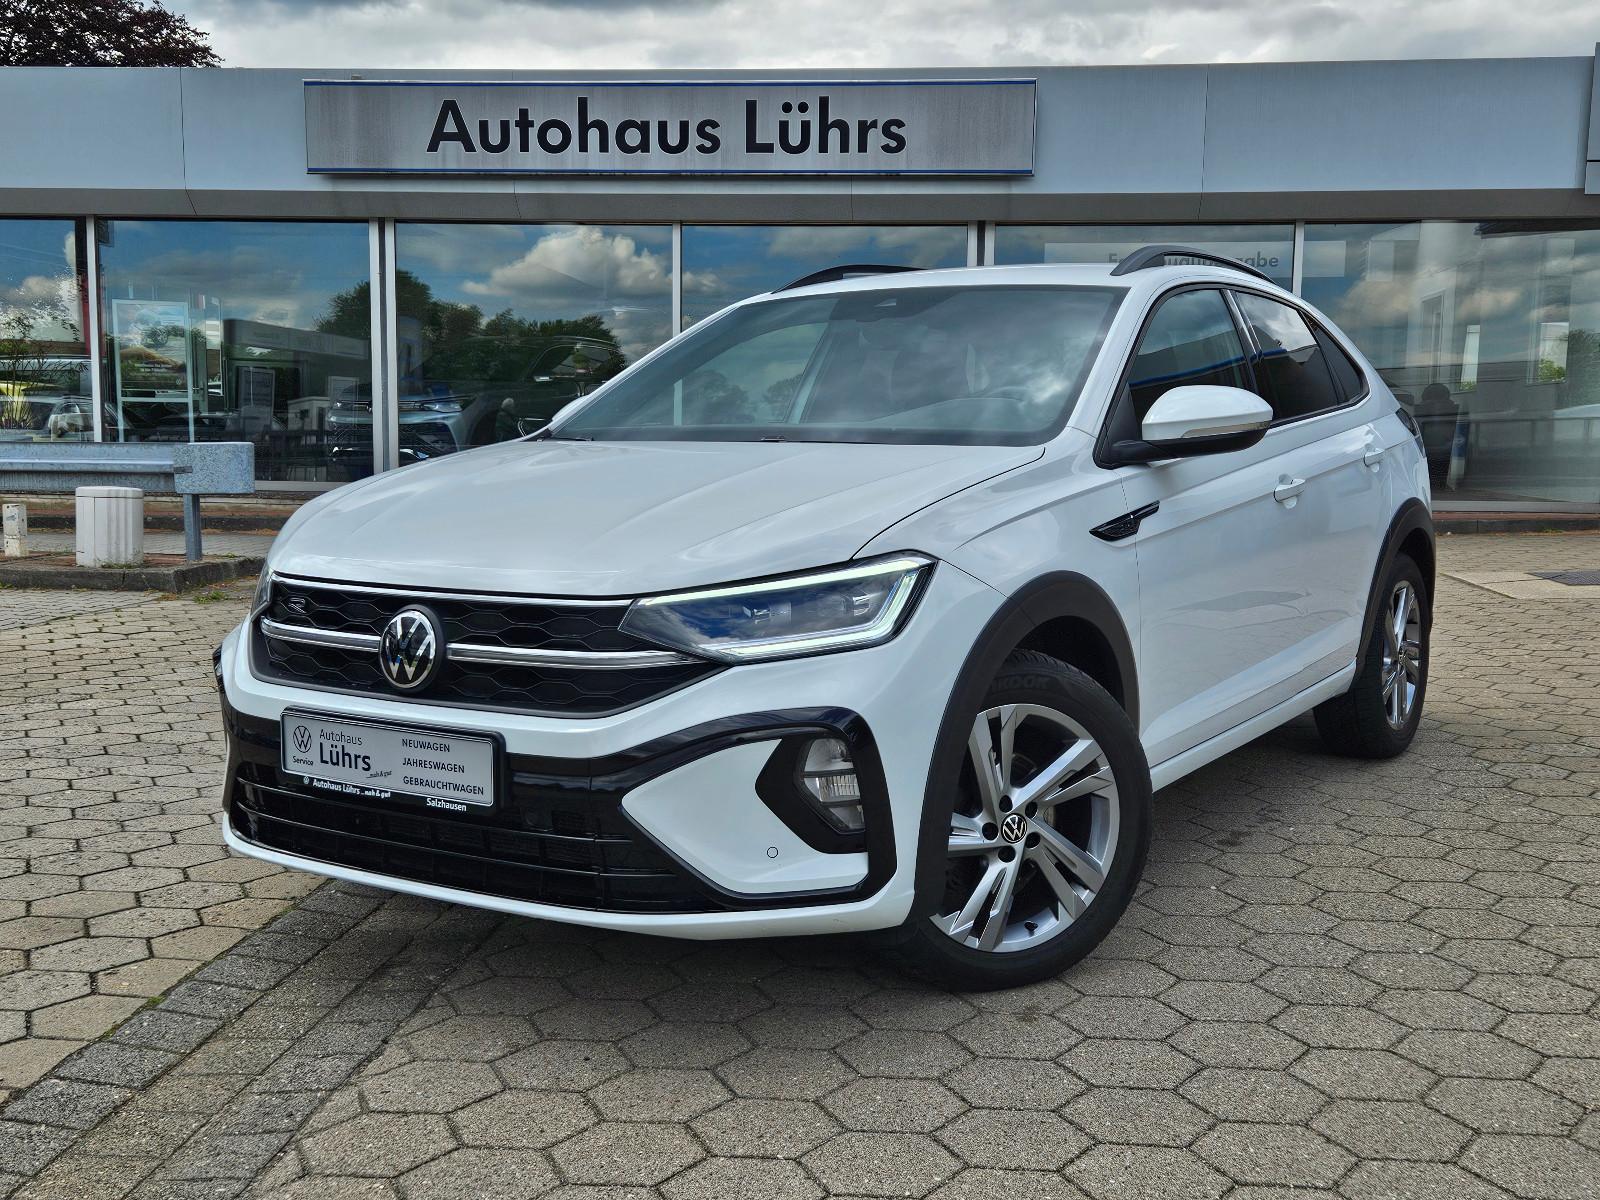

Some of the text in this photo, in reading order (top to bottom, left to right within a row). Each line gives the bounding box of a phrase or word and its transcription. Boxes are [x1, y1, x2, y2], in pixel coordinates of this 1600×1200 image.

[426, 95, 907, 155] Autohaus Lührs
[319, 728, 363, 747] Autohaus
[402, 738, 450, 753] NEUWAGEN
[292, 755, 314, 767] Service
[319, 742, 372, 772] Lührs
[402, 757, 465, 774] JAHRESWAGEN
[313, 779, 342, 791] Autohaus
[343, 784, 360, 795] Lührs
[403, 776, 484, 796] GEBRAUCHTWAGEN
[426, 797, 467, 812] Salzhausen
